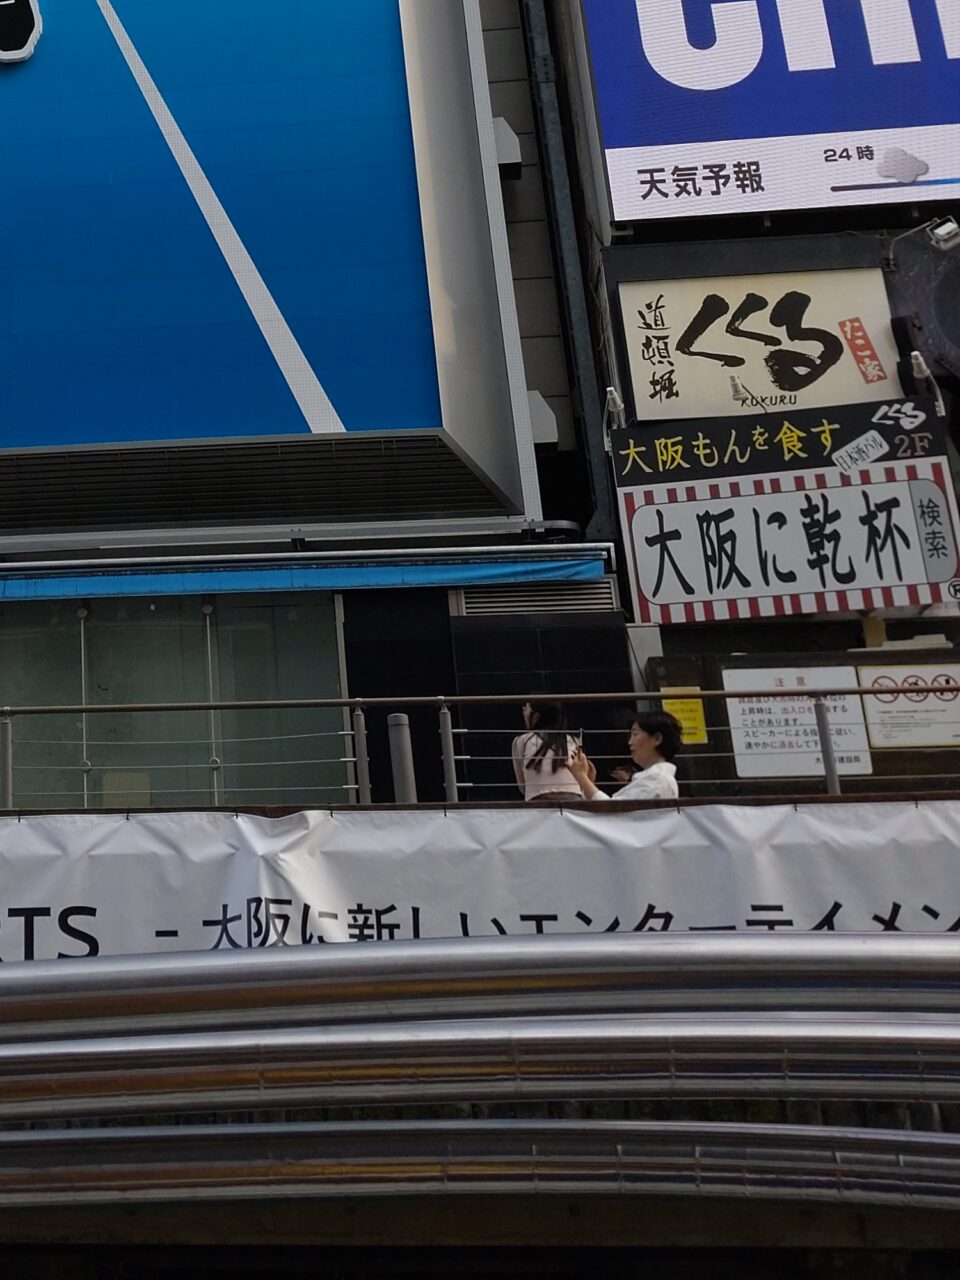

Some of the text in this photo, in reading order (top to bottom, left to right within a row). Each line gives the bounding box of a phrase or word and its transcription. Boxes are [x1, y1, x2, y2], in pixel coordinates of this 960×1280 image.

[823, 145, 875, 163] 24時
[637, 161, 765, 200] 天気予報
[637, 294, 679, 405] 道頓堀
[675, 290, 844, 392] くくる
[741, 394, 797, 407] KUKURU
[871, 402, 927, 430] くくる
[619, 419, 841, 477] 大阪もんを食す
[836, 435, 883, 473] 日本酒バル
[894, 432, 933, 457] 2F
[645, 490, 910, 598] 大阪に乾杯
[918, 497, 948, 559] 検索
